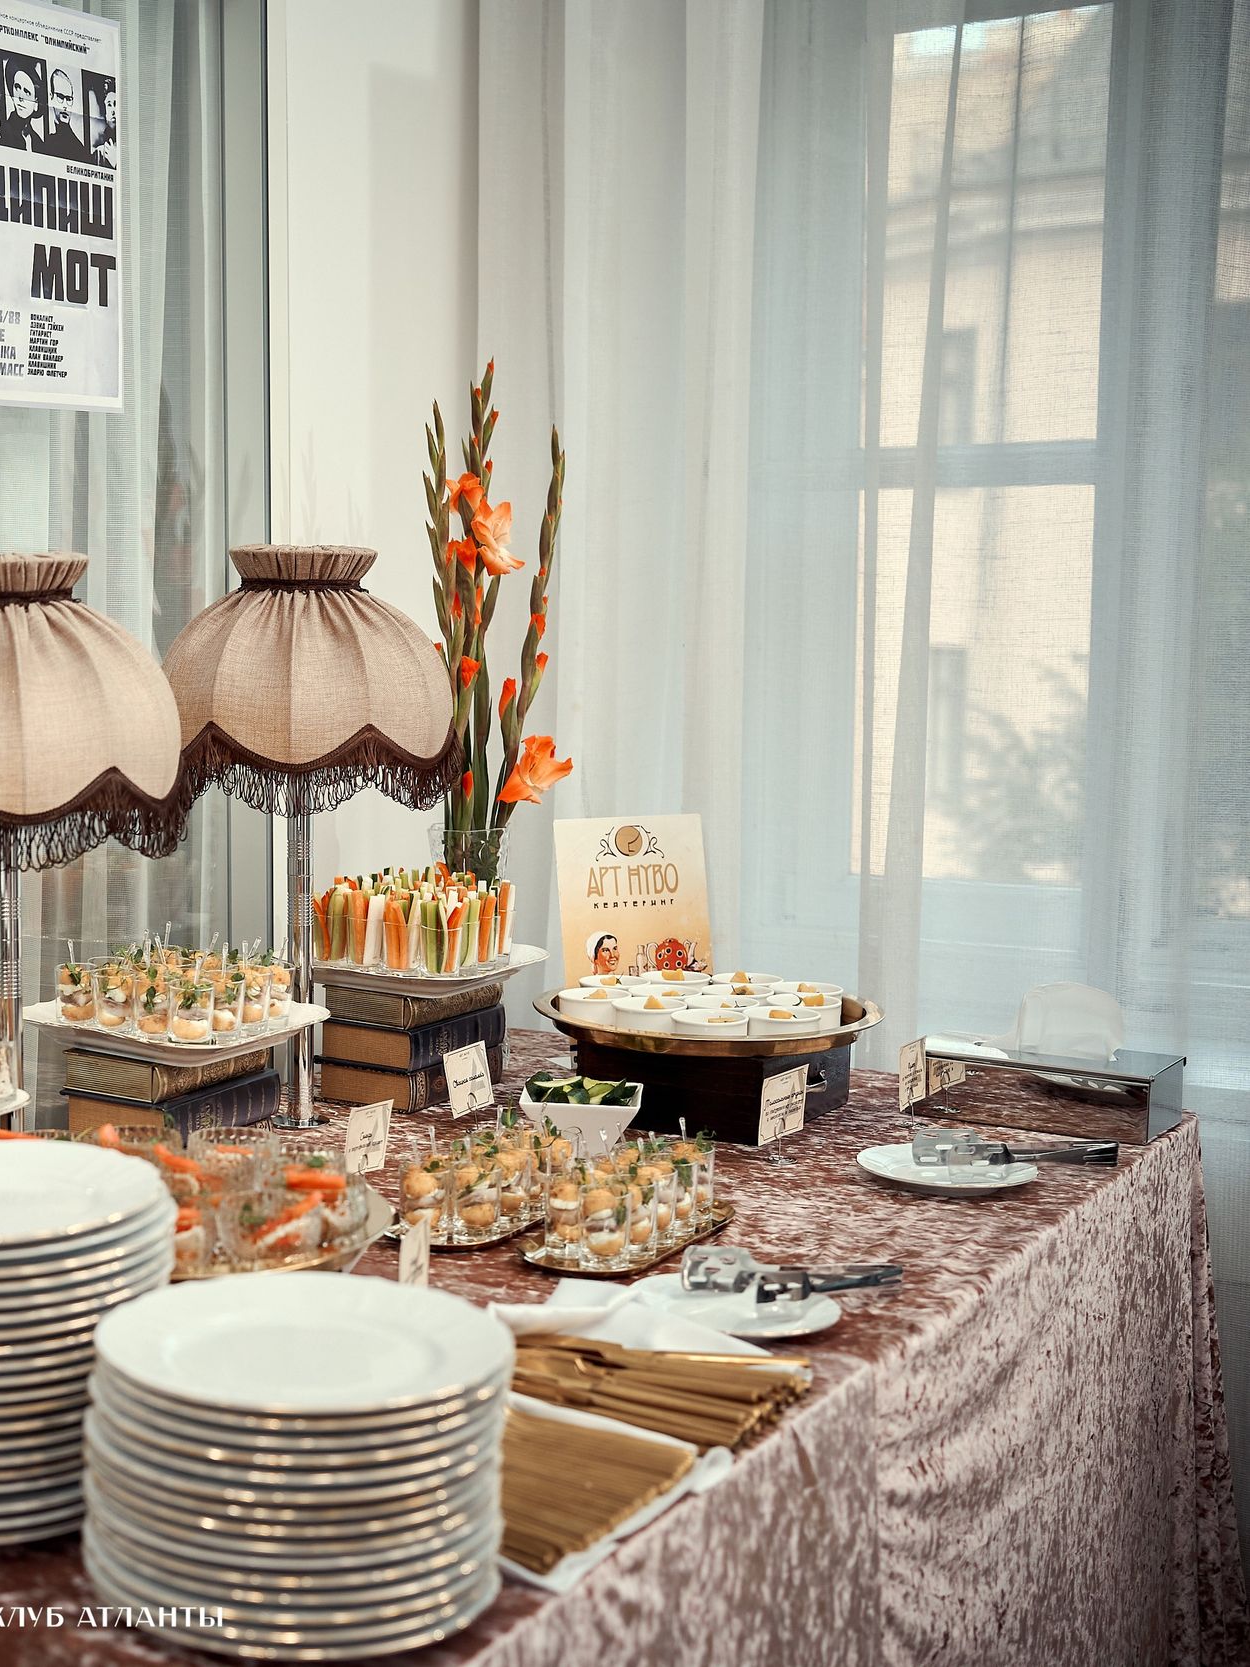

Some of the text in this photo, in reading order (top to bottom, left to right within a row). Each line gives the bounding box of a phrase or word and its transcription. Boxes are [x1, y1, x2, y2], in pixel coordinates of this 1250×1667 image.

[66, 164, 114, 183] ВЕЛИКОБРИТАНИЯ
[31, 243, 117, 307] МОТ
[29, 329, 53, 338] ГИТАРИСТ
[29, 337, 59, 347] МАРТИН ГОР
[28, 352, 41, 361] АЛАН
[27, 368, 68, 378] ЭНДРЮ ФЛЕТЧЕР
[587, 866, 621, 897] АРТ
